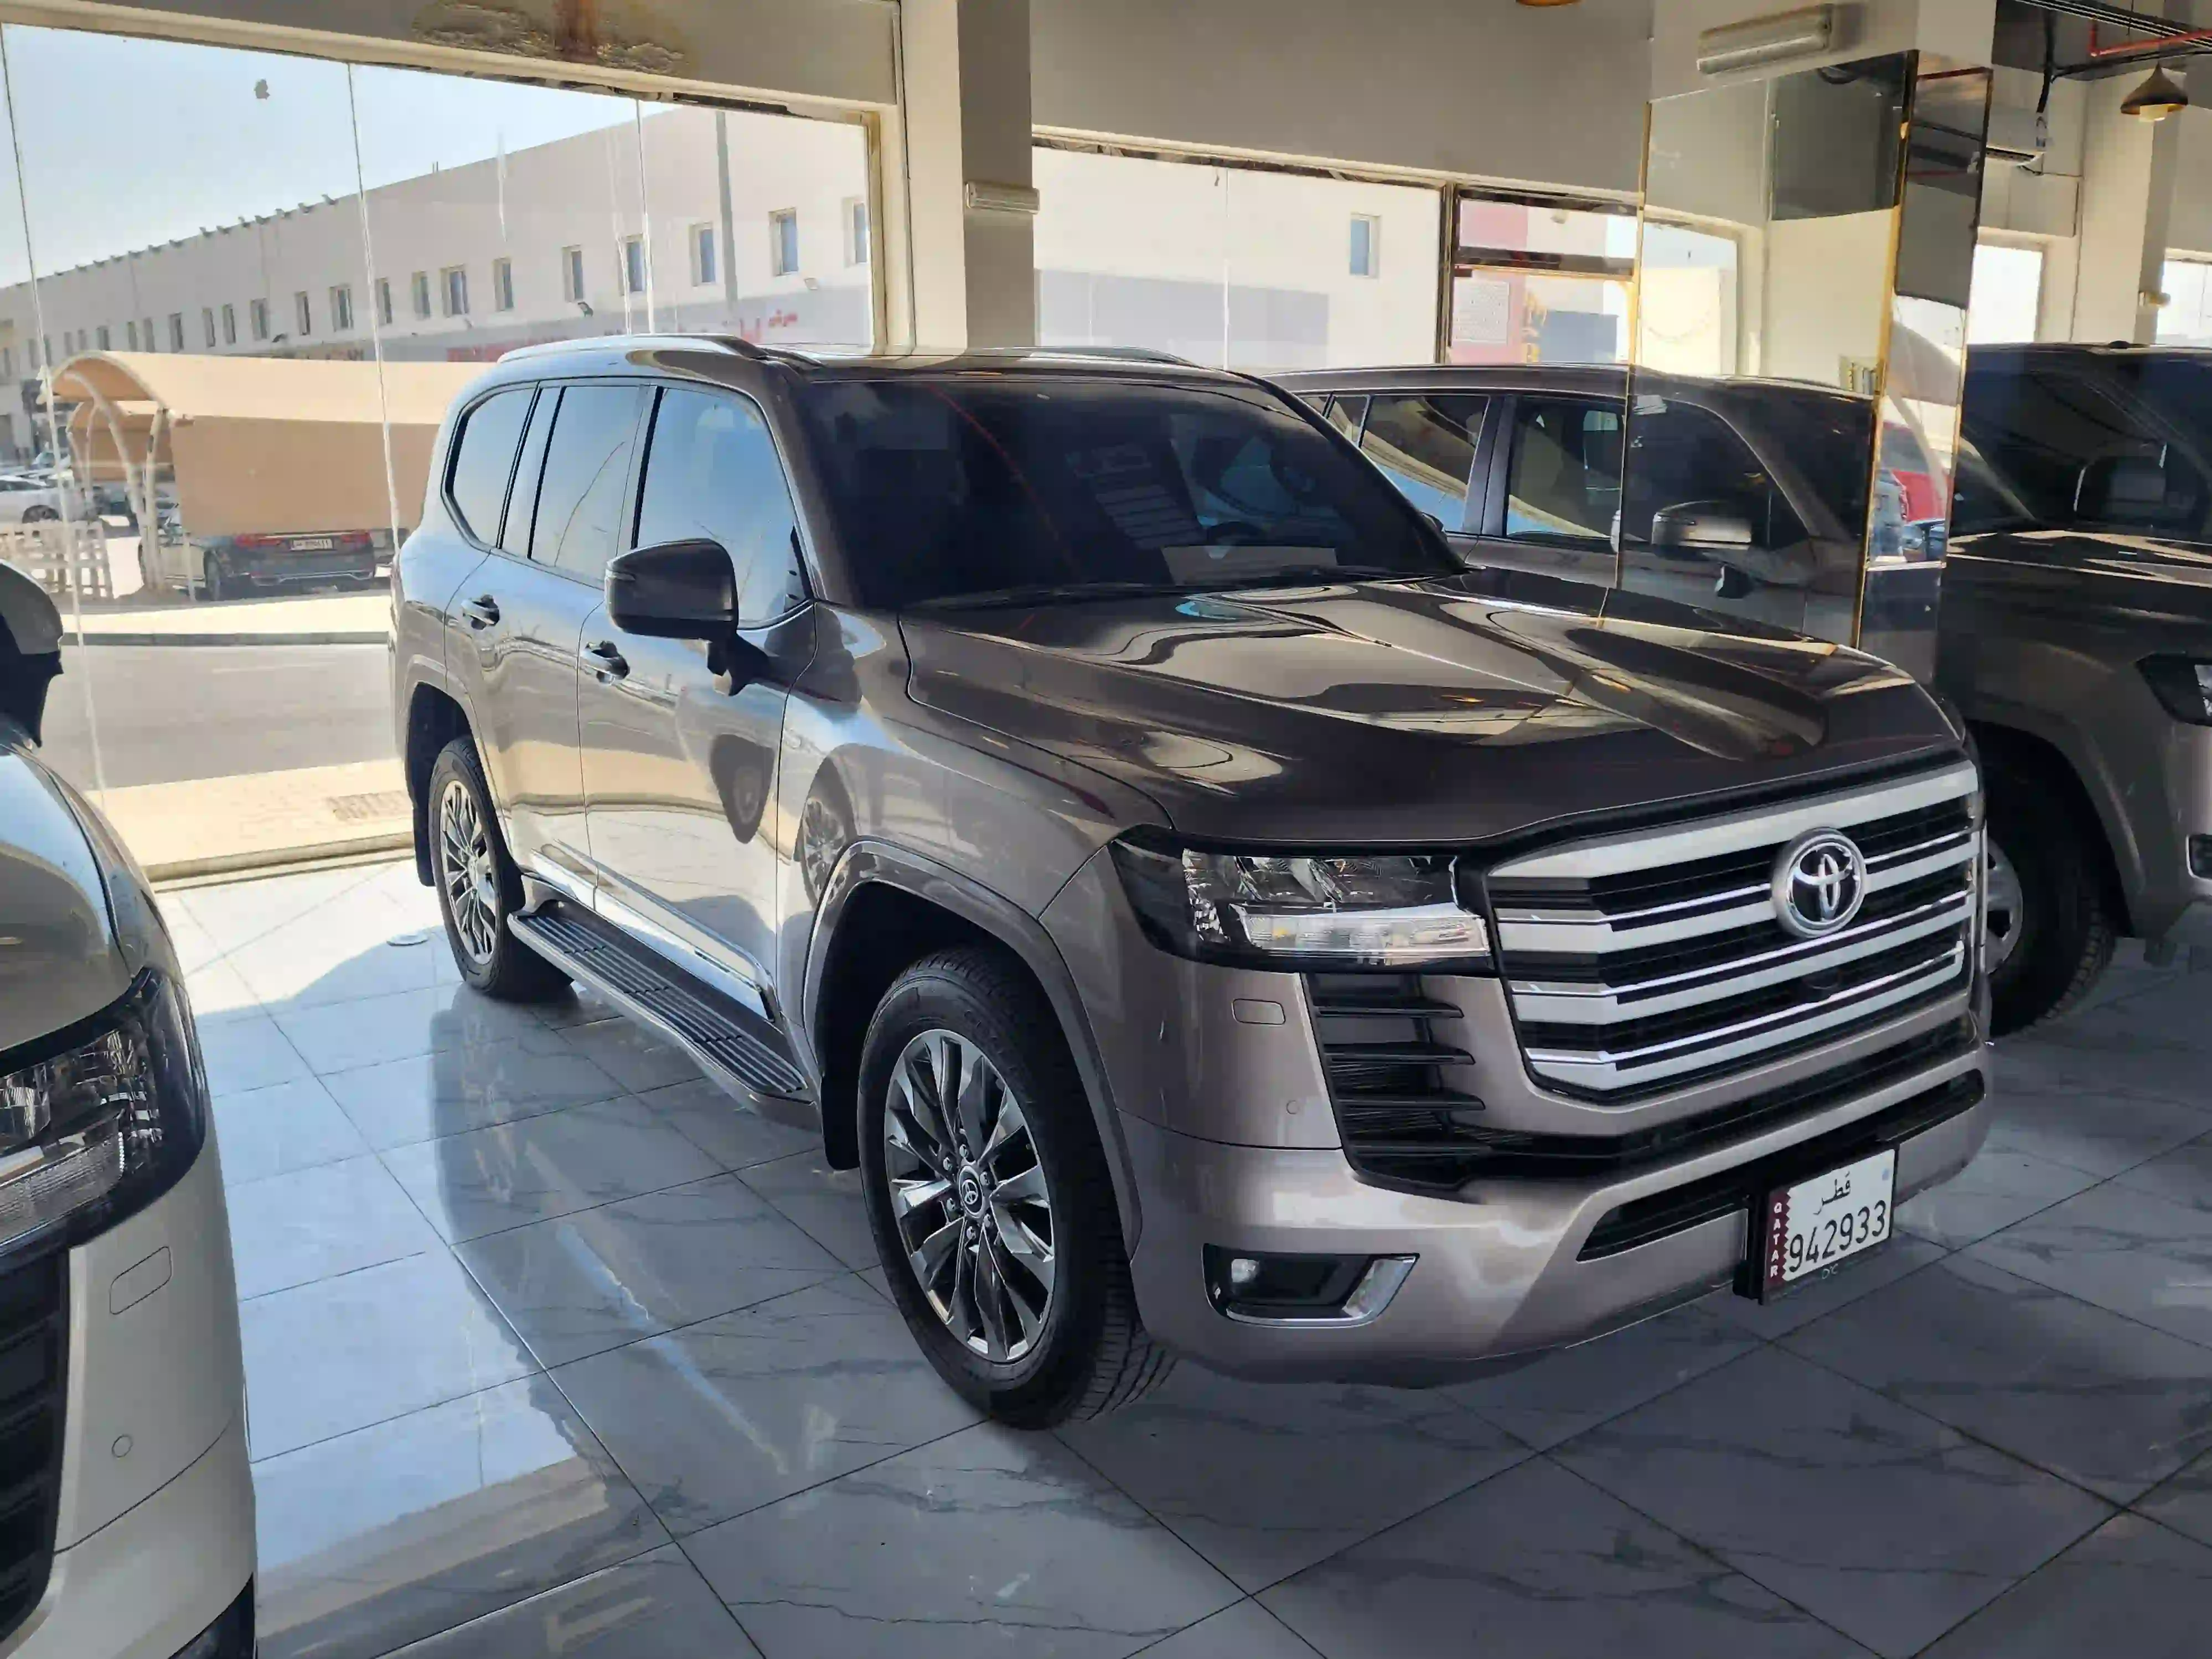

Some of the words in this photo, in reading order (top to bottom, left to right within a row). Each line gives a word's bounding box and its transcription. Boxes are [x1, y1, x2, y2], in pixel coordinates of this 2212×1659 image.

[1813, 1171, 1851, 1214] قطر
[1770, 1202, 1782, 1277] QATAR
[1789, 1200, 1886, 1272] 942933
